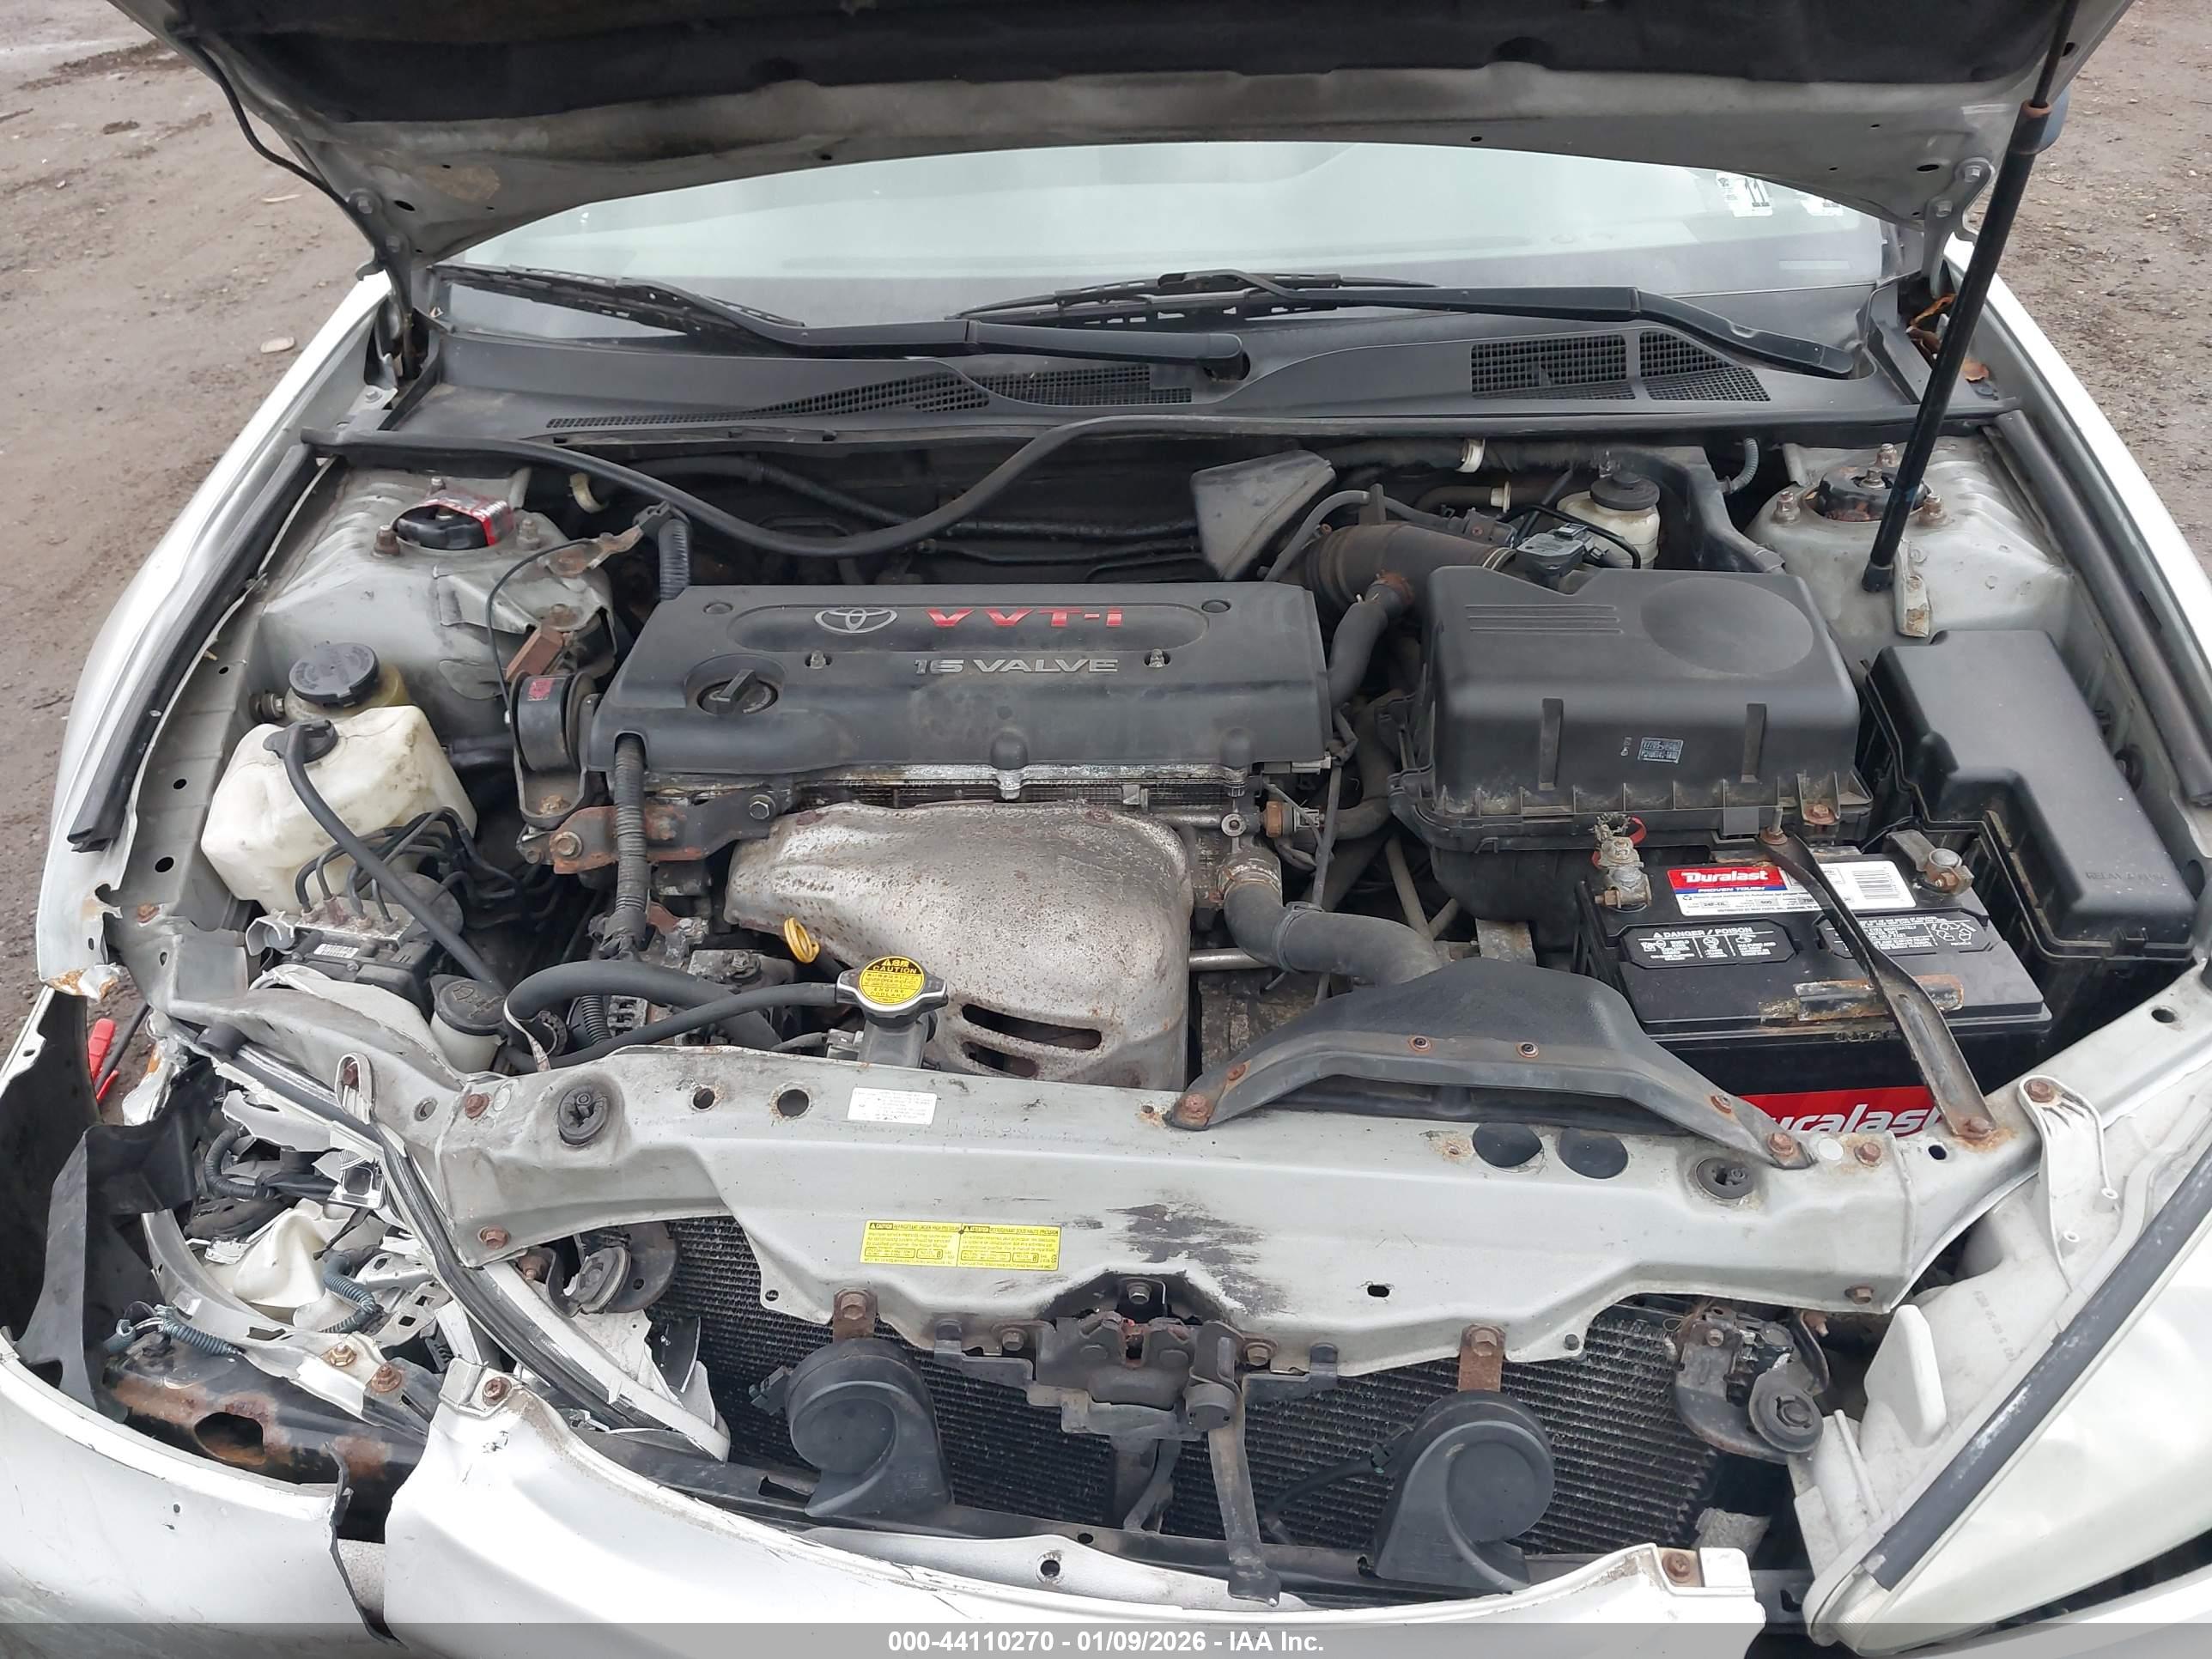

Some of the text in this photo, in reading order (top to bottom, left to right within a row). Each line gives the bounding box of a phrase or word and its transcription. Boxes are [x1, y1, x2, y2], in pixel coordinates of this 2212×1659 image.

[914, 659, 1118, 674] 16 VALVE
[1680, 871, 1768, 883] Duralast
[1662, 930, 1705, 939] DANGER
[1715, 927, 1753, 935] POISON
[872, 965, 917, 974] CAUTION
